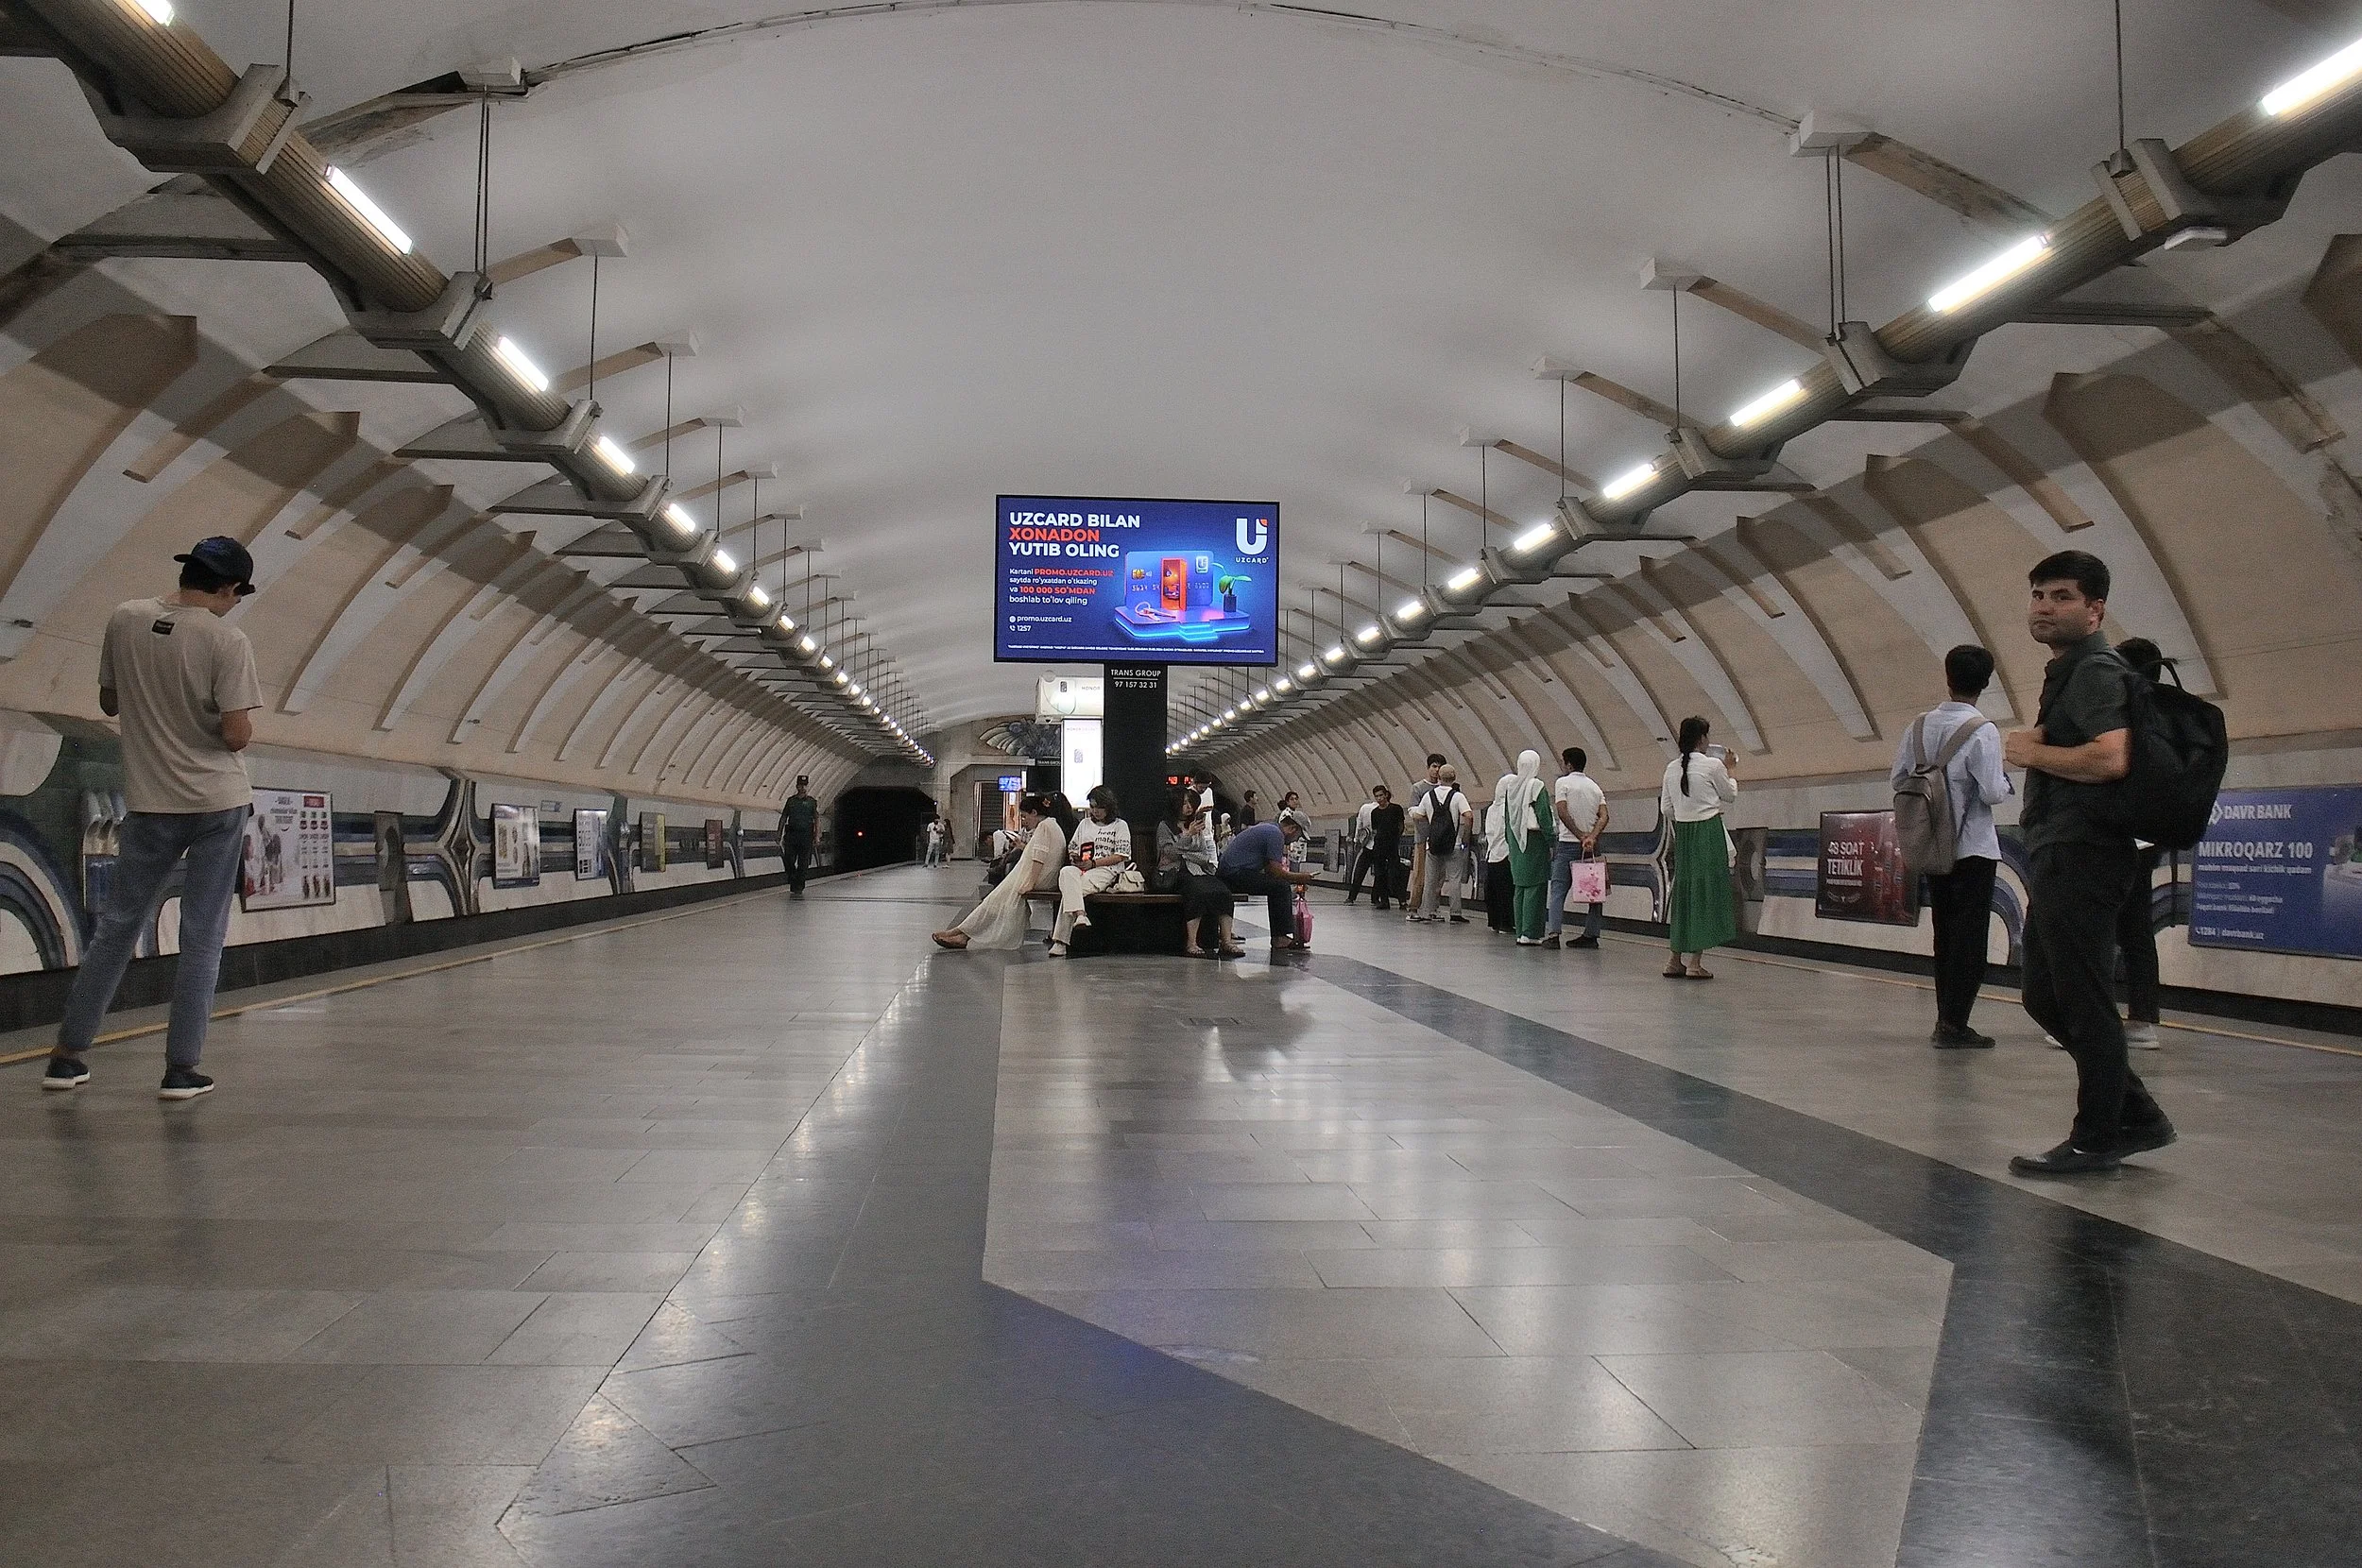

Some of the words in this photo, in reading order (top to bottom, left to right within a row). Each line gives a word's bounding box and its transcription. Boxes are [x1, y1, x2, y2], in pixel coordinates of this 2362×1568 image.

[1009, 512, 1084, 527] UZCARD
[1087, 514, 1140, 528] BILAN
[1009, 528, 1100, 542] XONADON
[1009, 542, 1061, 556] YUTIB
[1065, 543, 1120, 557] OLING
[1065, 596, 1087, 605] qiling
[2224, 805, 2254, 820] DAVR
[2257, 804, 2292, 819] BANK
[1840, 841, 1865, 856] SOAT
[2198, 842, 2284, 861] MIKROQARZ
[2287, 842, 2314, 859] 100
